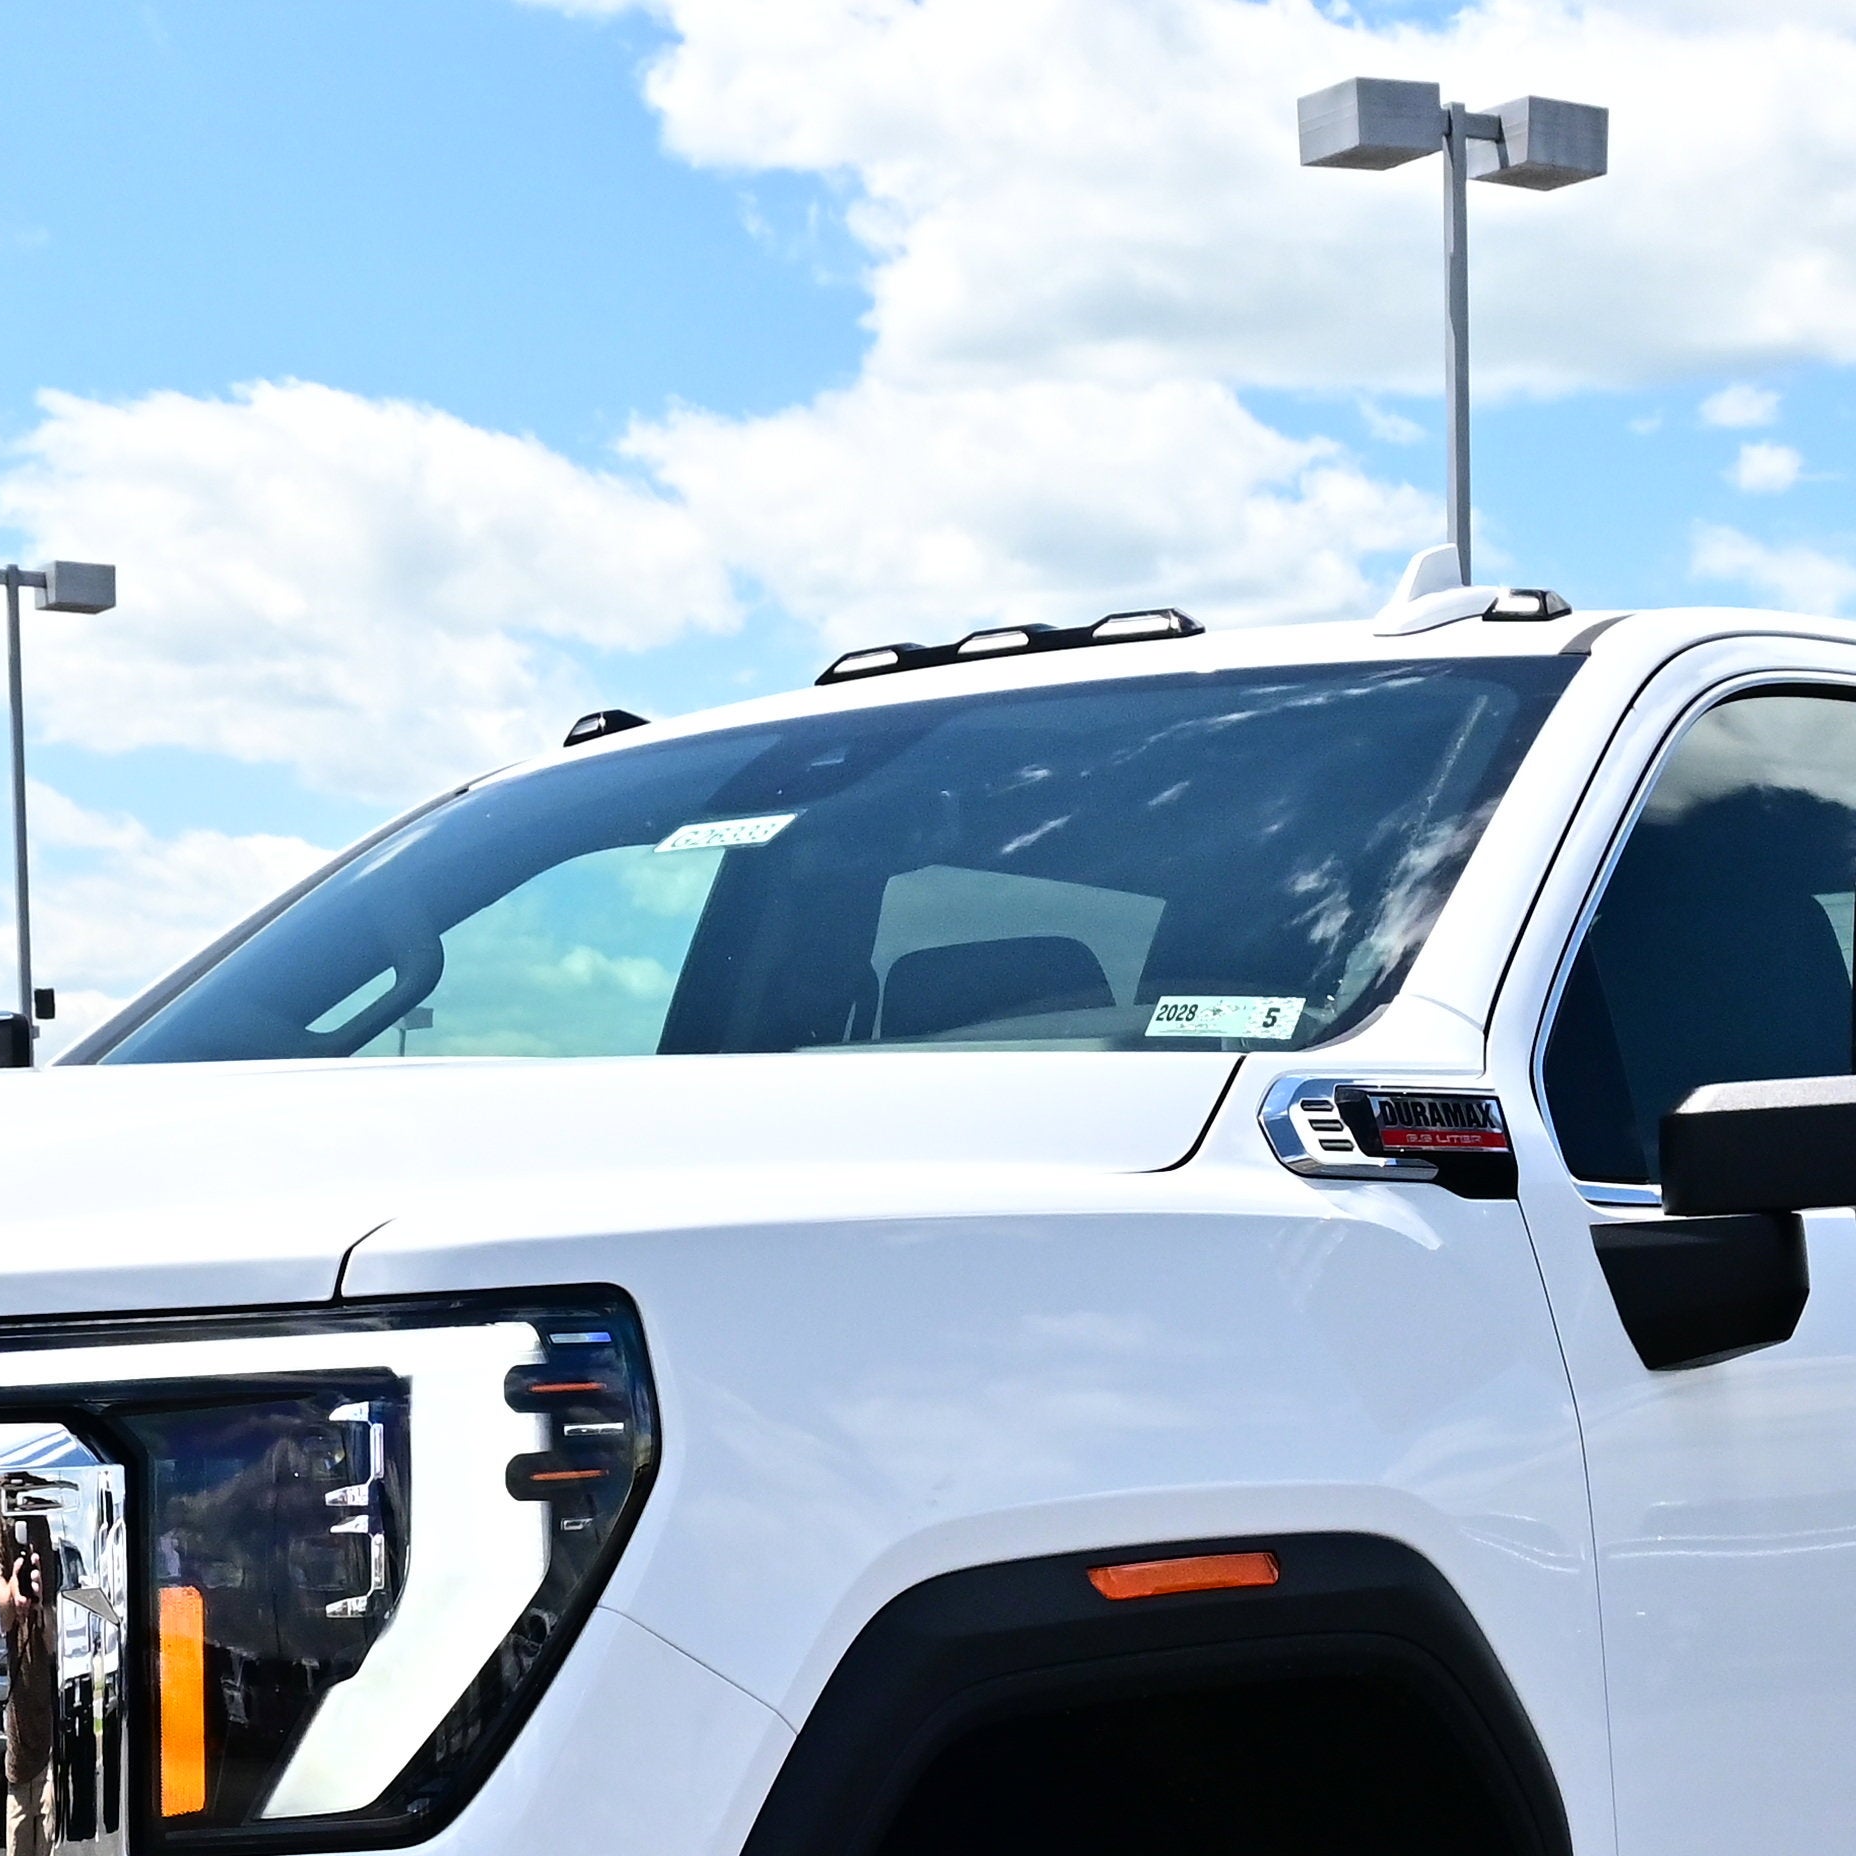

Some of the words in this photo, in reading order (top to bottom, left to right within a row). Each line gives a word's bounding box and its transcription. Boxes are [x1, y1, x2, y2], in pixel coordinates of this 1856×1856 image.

[1155, 1003, 1199, 1022] 2028
[1262, 1007, 1281, 1029] 5
[1378, 1099, 1496, 1129] DURAMAX
[1436, 1133, 1482, 1144] LITER
